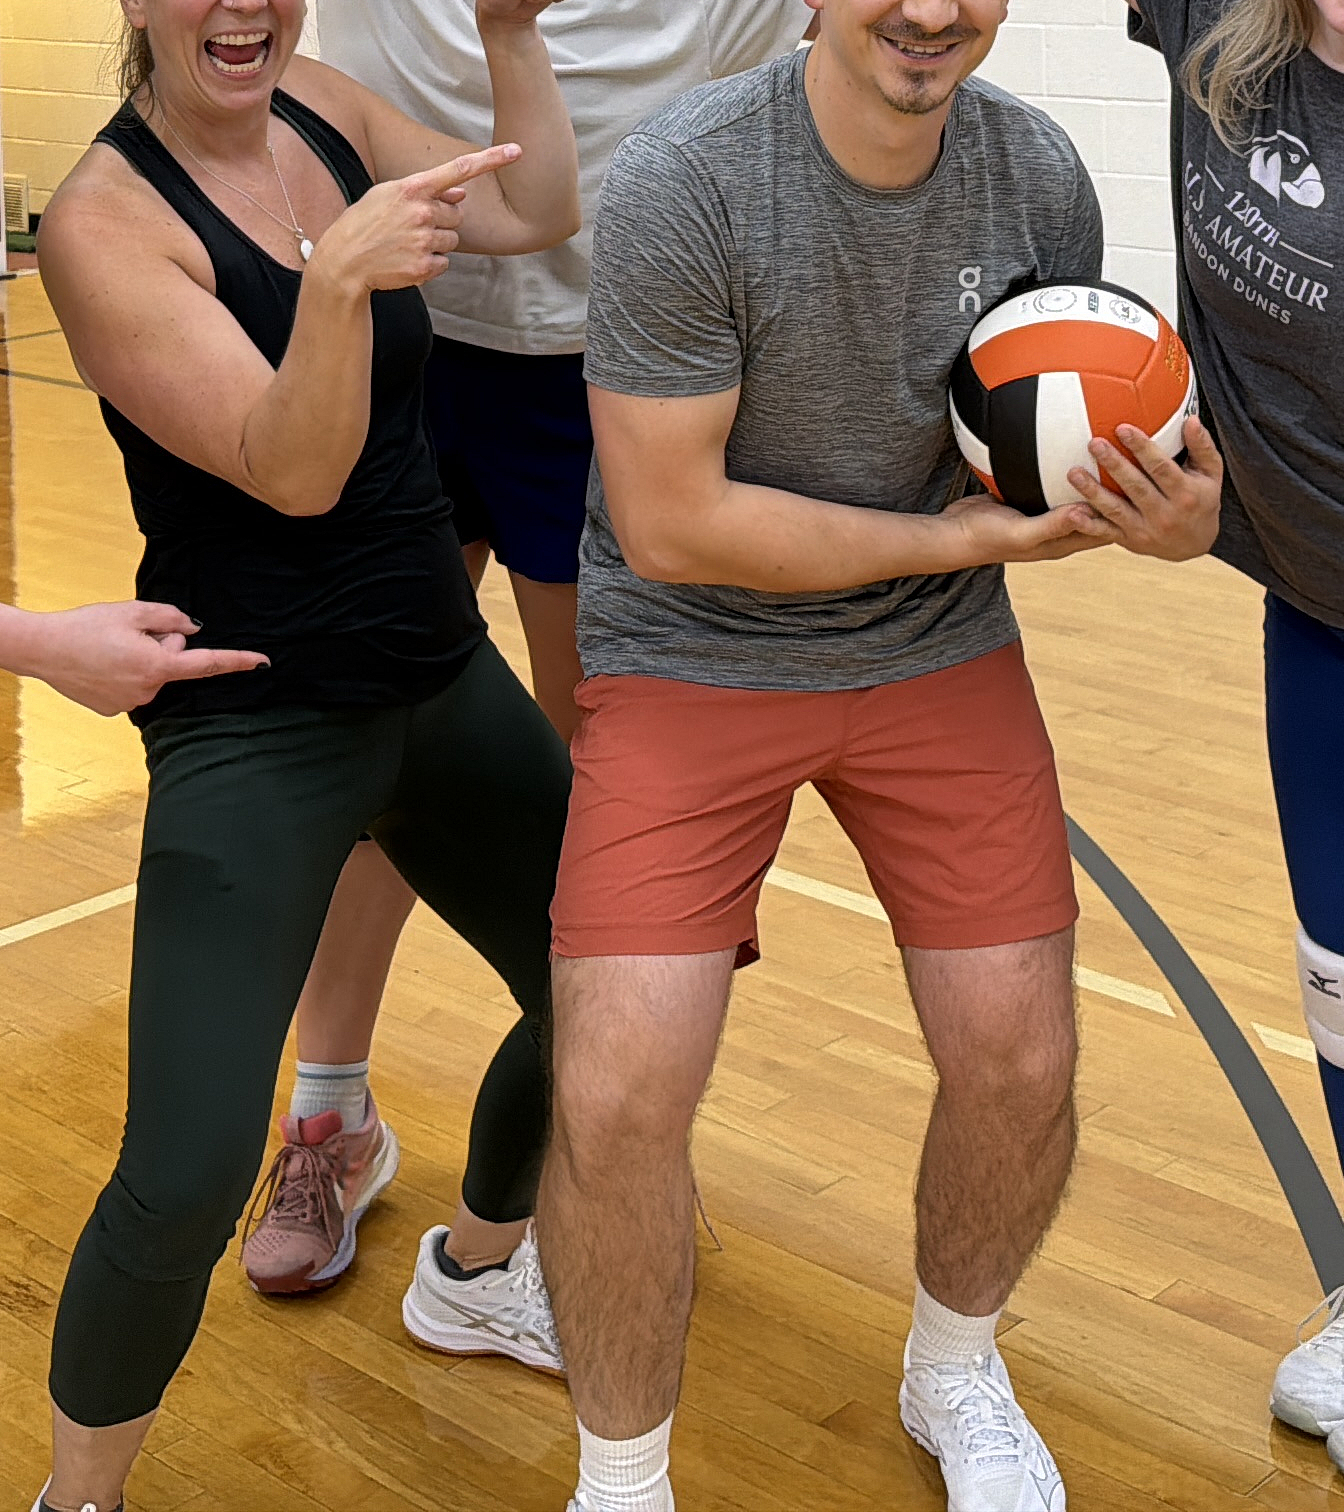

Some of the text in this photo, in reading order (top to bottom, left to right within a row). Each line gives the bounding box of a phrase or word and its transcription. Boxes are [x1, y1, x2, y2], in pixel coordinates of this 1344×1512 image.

[1183, 209, 1292, 325] BANDON DUNES
[1184, 161, 1329, 313] U.S. AMATEUR
[1225, 190, 1281, 248] 120TH
